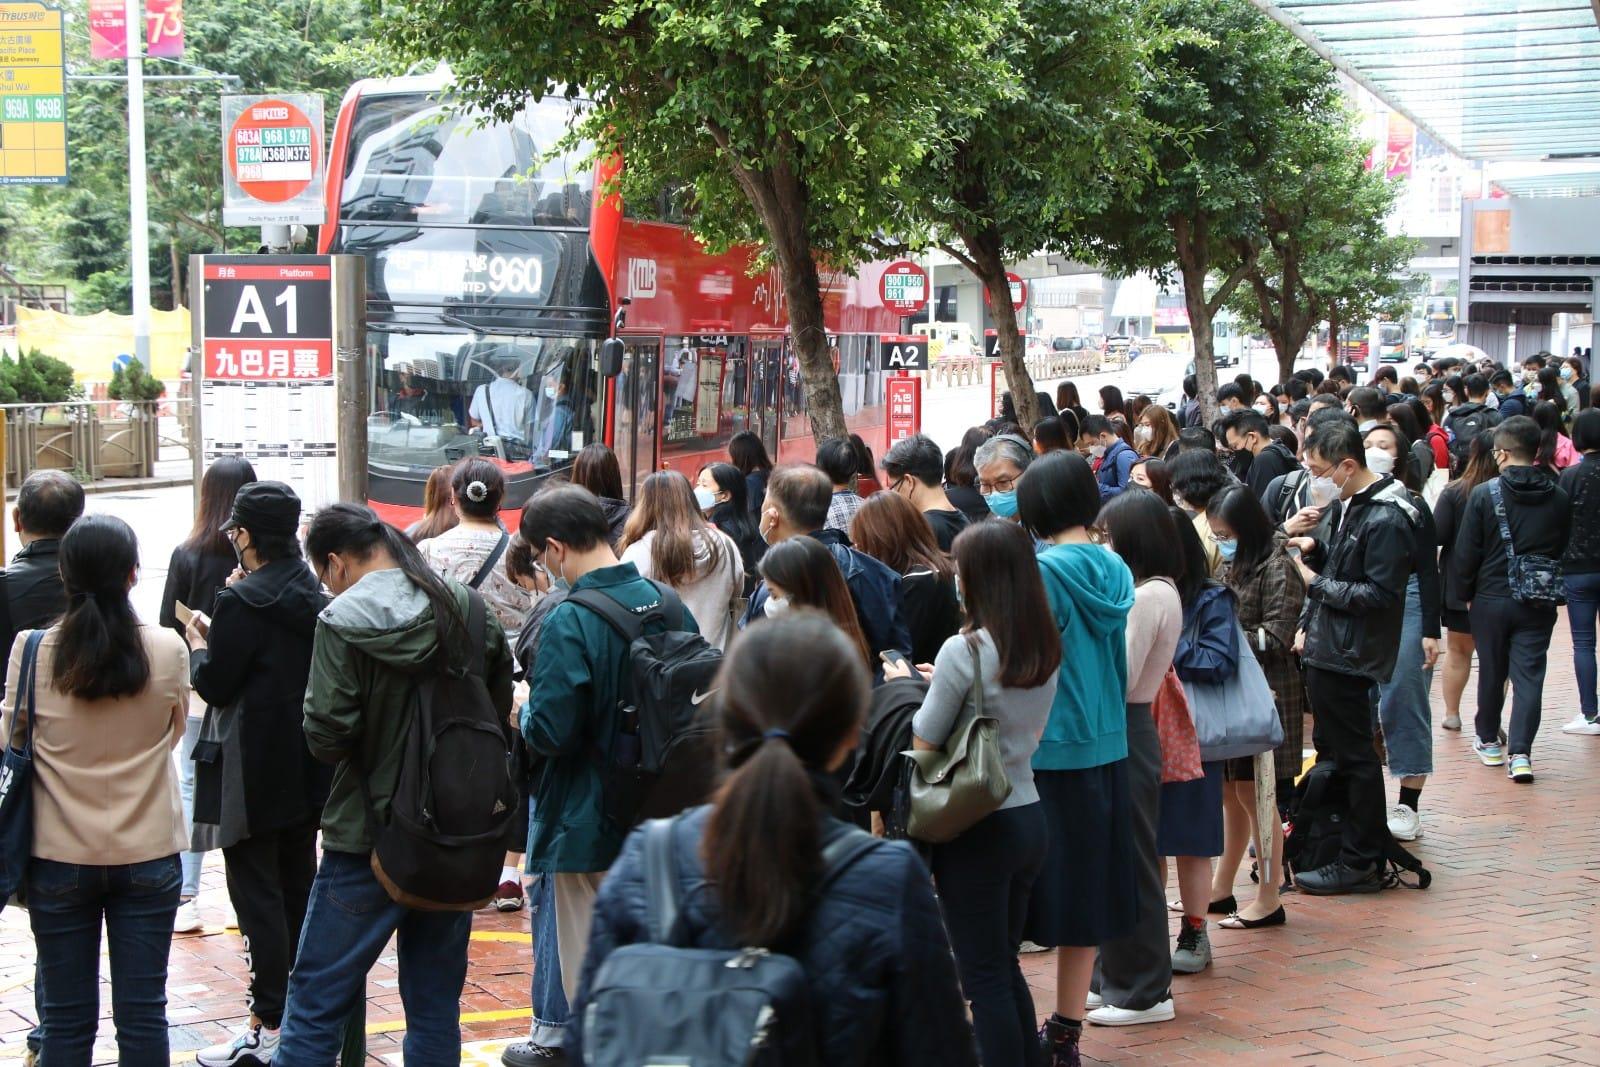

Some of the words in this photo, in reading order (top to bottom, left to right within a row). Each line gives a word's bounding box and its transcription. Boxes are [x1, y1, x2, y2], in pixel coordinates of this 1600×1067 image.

[147, 6, 182, 44] 73
[5, 99, 29, 119] 969A
[35, 98, 61, 119] 969B
[264, 130, 283, 143] 968
[289, 129, 308, 142] 978
[238, 148, 262, 162] 978A
[262, 148, 285, 161] N368
[287, 147, 310, 161] N373
[218, 267, 236, 278] 月台
[280, 268, 314, 278] Platform
[489, 256, 543, 293] 960
[887, 276, 902, 286] 900
[907, 277, 922, 286] 960
[887, 288, 902, 299] 961
[230, 285, 298, 334] A1
[216, 347, 320, 377] 九巴月票
[889, 345, 920, 366] A2
[893, 393, 912, 403] 九巴
